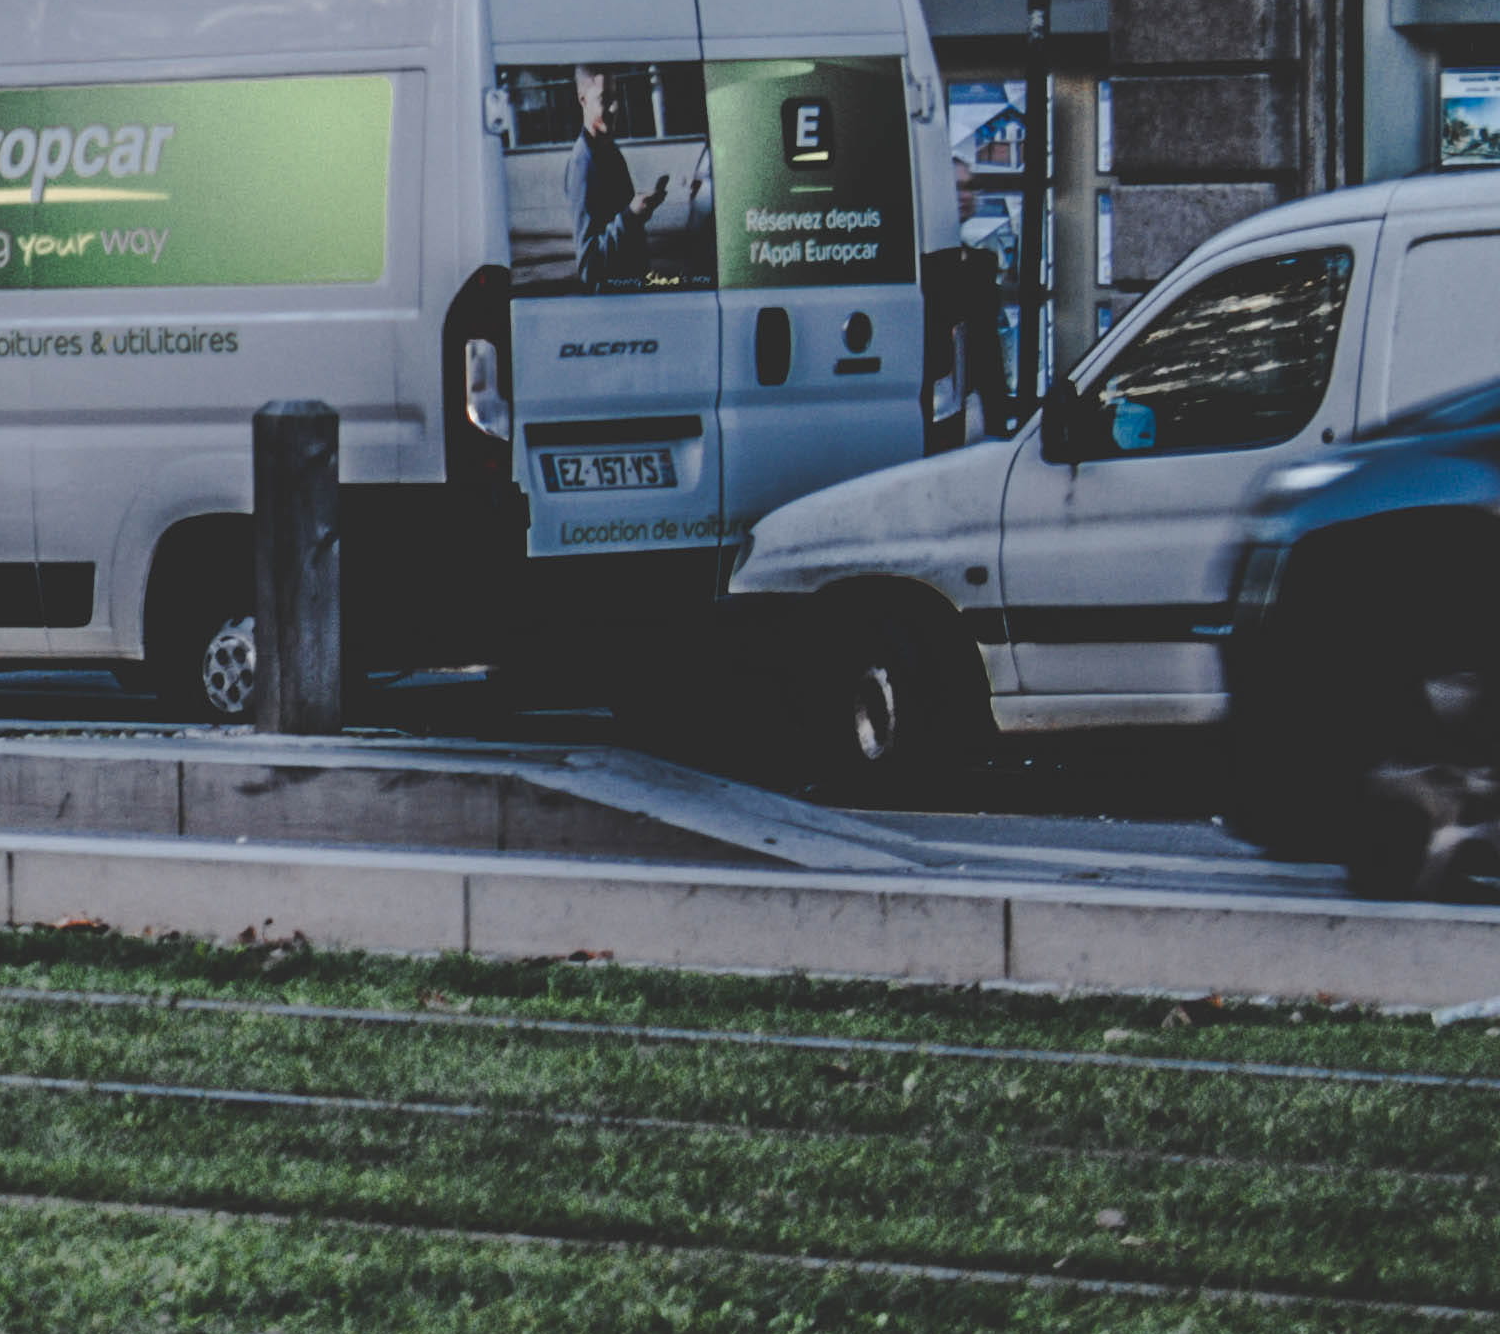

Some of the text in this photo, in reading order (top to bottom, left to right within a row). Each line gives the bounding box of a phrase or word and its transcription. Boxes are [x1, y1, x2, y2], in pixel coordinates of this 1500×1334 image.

[796, 106, 820, 147] E
[746, 206, 881, 232] Réservez depuis
[18, 230, 95, 266] your
[101, 226, 170, 263] way
[805, 239, 878, 264] Europcar
[91, 331, 107, 353] &
[113, 327, 238, 354] utilitaires
[559, 340, 658, 358] DUCATO
[561, 519, 650, 545] Location
[652, 517, 678, 540] de
